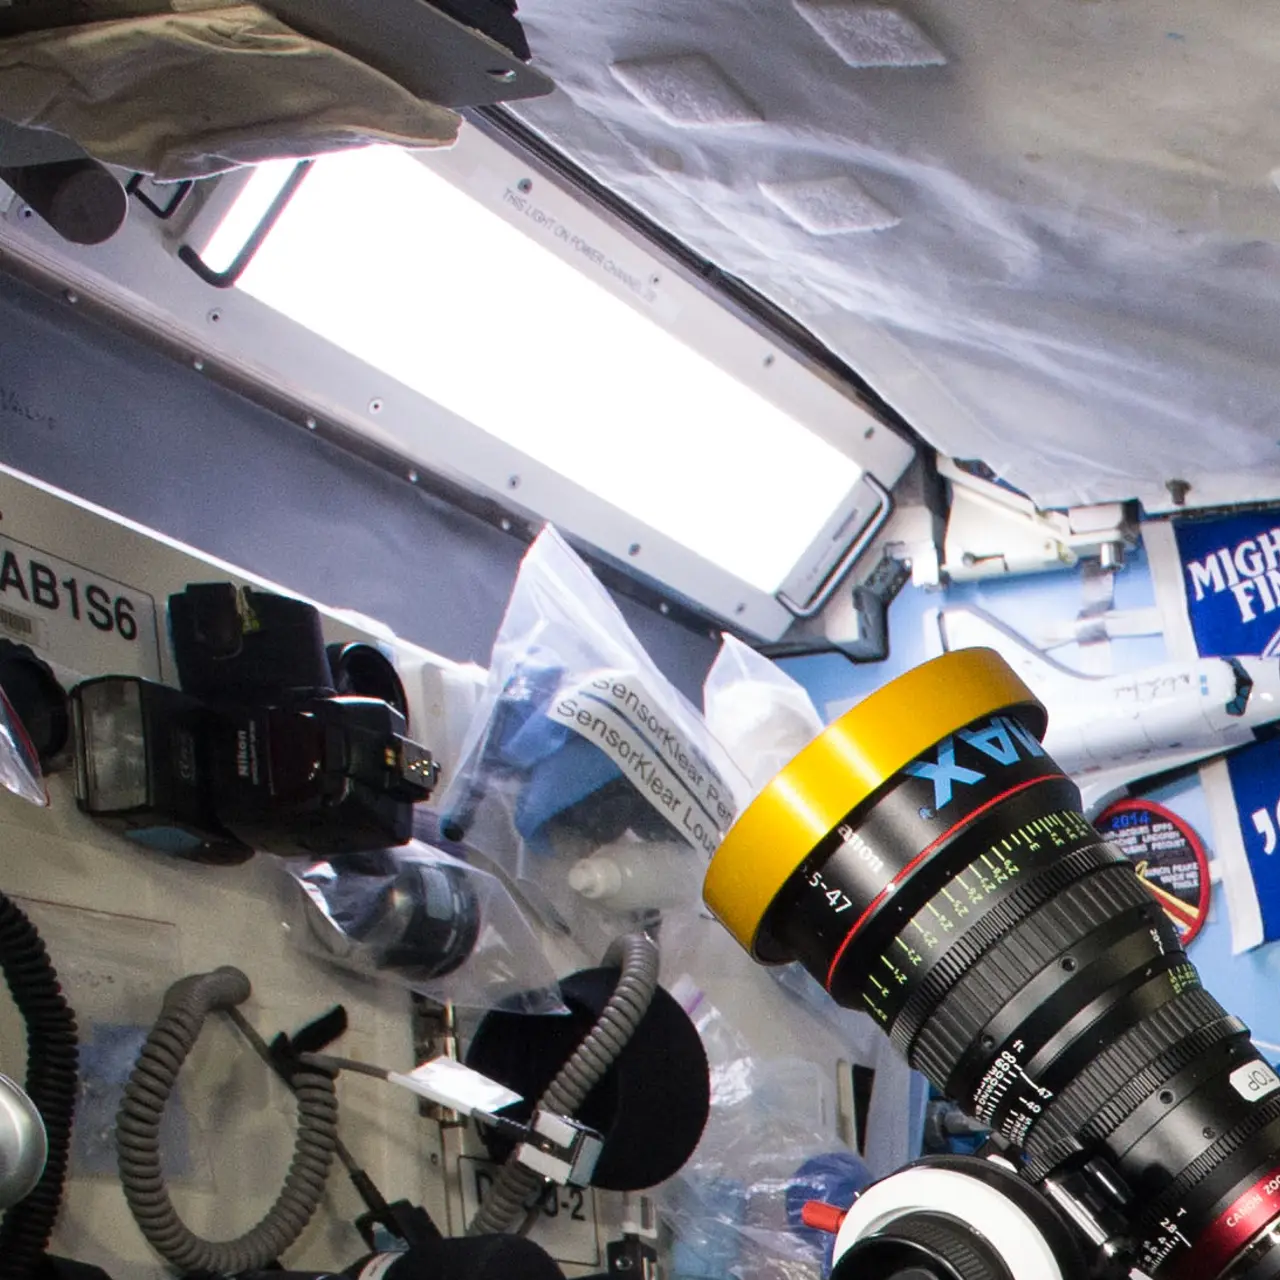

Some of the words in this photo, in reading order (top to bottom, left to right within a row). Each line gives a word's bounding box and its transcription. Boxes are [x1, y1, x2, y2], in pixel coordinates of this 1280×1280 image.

[236, 729, 248, 777] Nikon
[557, 698, 682, 813] SensorKlear
[592, 677, 704, 787] SensorKlear
[1111, 811, 1150, 829] 2014
[838, 823, 885, 873] anon
[1247, 1068, 1275, 1091] TOP
[1226, 1191, 1265, 1227] CANON
